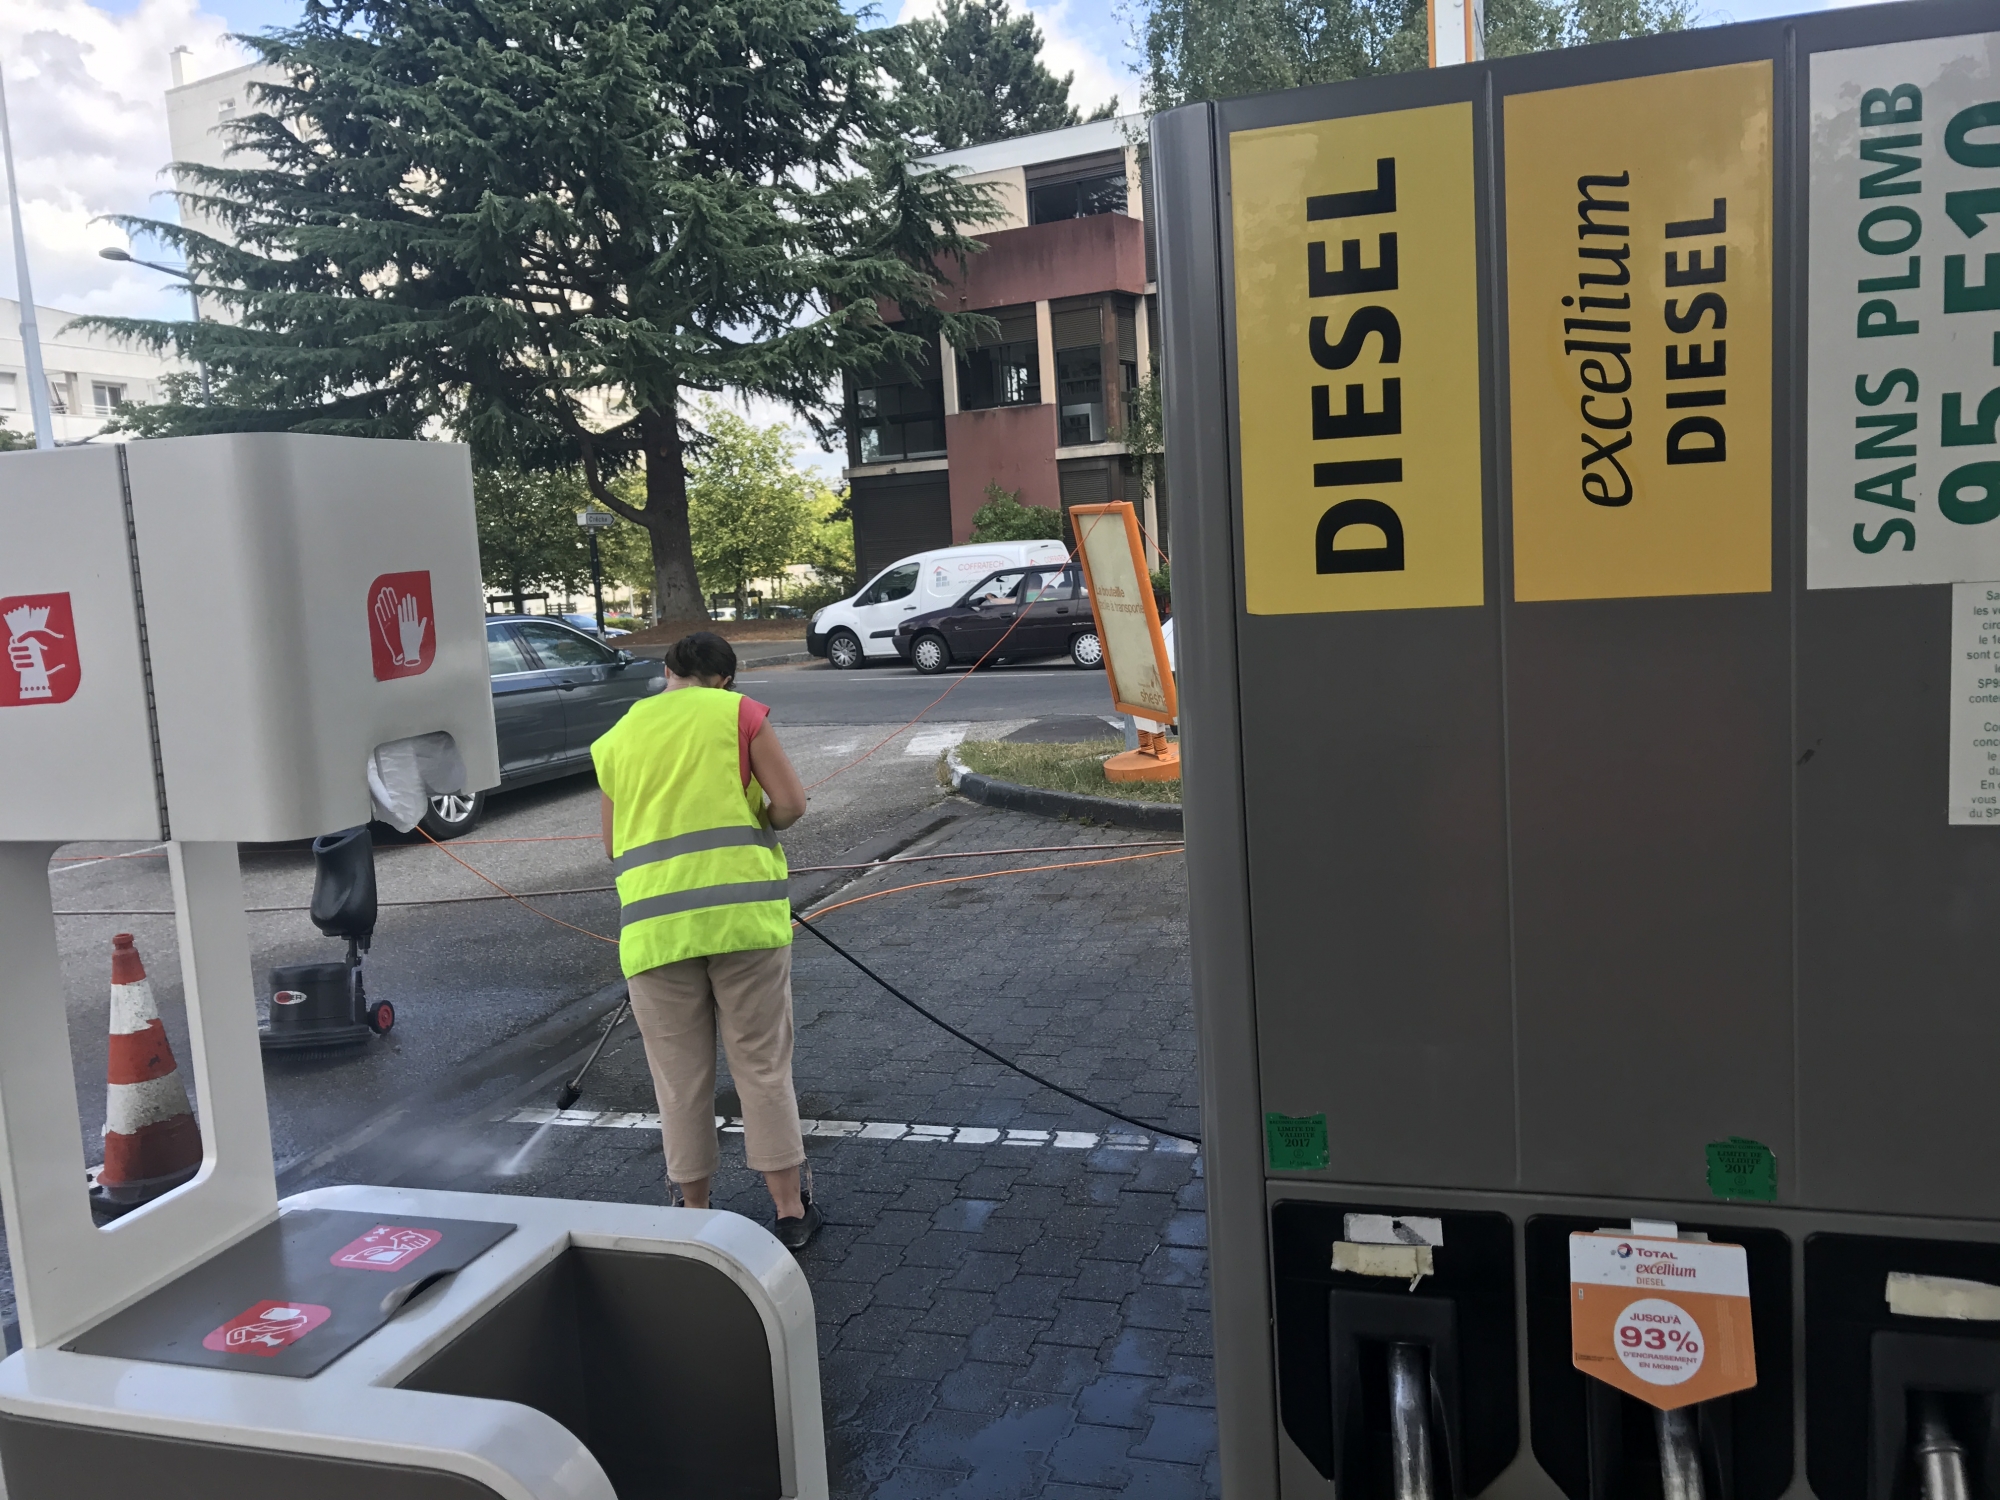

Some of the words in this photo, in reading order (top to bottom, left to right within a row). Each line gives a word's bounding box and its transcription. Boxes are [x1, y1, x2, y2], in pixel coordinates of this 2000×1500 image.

[1857, 82, 1923, 339] PLOMB
[1664, 198, 1727, 465] DIESEL
[1560, 170, 1633, 507] excellium
[1306, 157, 1405, 575] DIESEL
[1852, 368, 1920, 554] SANS
[957, 560, 1004, 571] COFFRATECH
[1973, 606, 1989, 615] les
[1979, 635, 1988, 645] le
[1966, 650, 1990, 660] sont
[1977, 678, 2000, 688] SP9
[1968, 694, 2000, 704] conte
[1973, 739, 2000, 747] conc
[1987, 751, 1997, 761] le
[1980, 779, 1995, 790] En
[1971, 796, 1997, 804] vous
[1969, 808, 1983, 818] du
[1284, 1138, 1310, 1148] 2017
[1725, 1164, 1755, 1175] 2017
[1635, 1247, 1678, 1260] TOTAL
[1636, 1262, 1697, 1278] excellium
[1636, 1276, 1666, 1287] DIESEL
[1629, 1312, 1682, 1325] JUSQU'À
[1620, 1326, 1699, 1353] 93%
[1623, 1351, 1697, 1364] D'ENCRASSEMENT
[1639, 1361, 1651, 1369] EN
